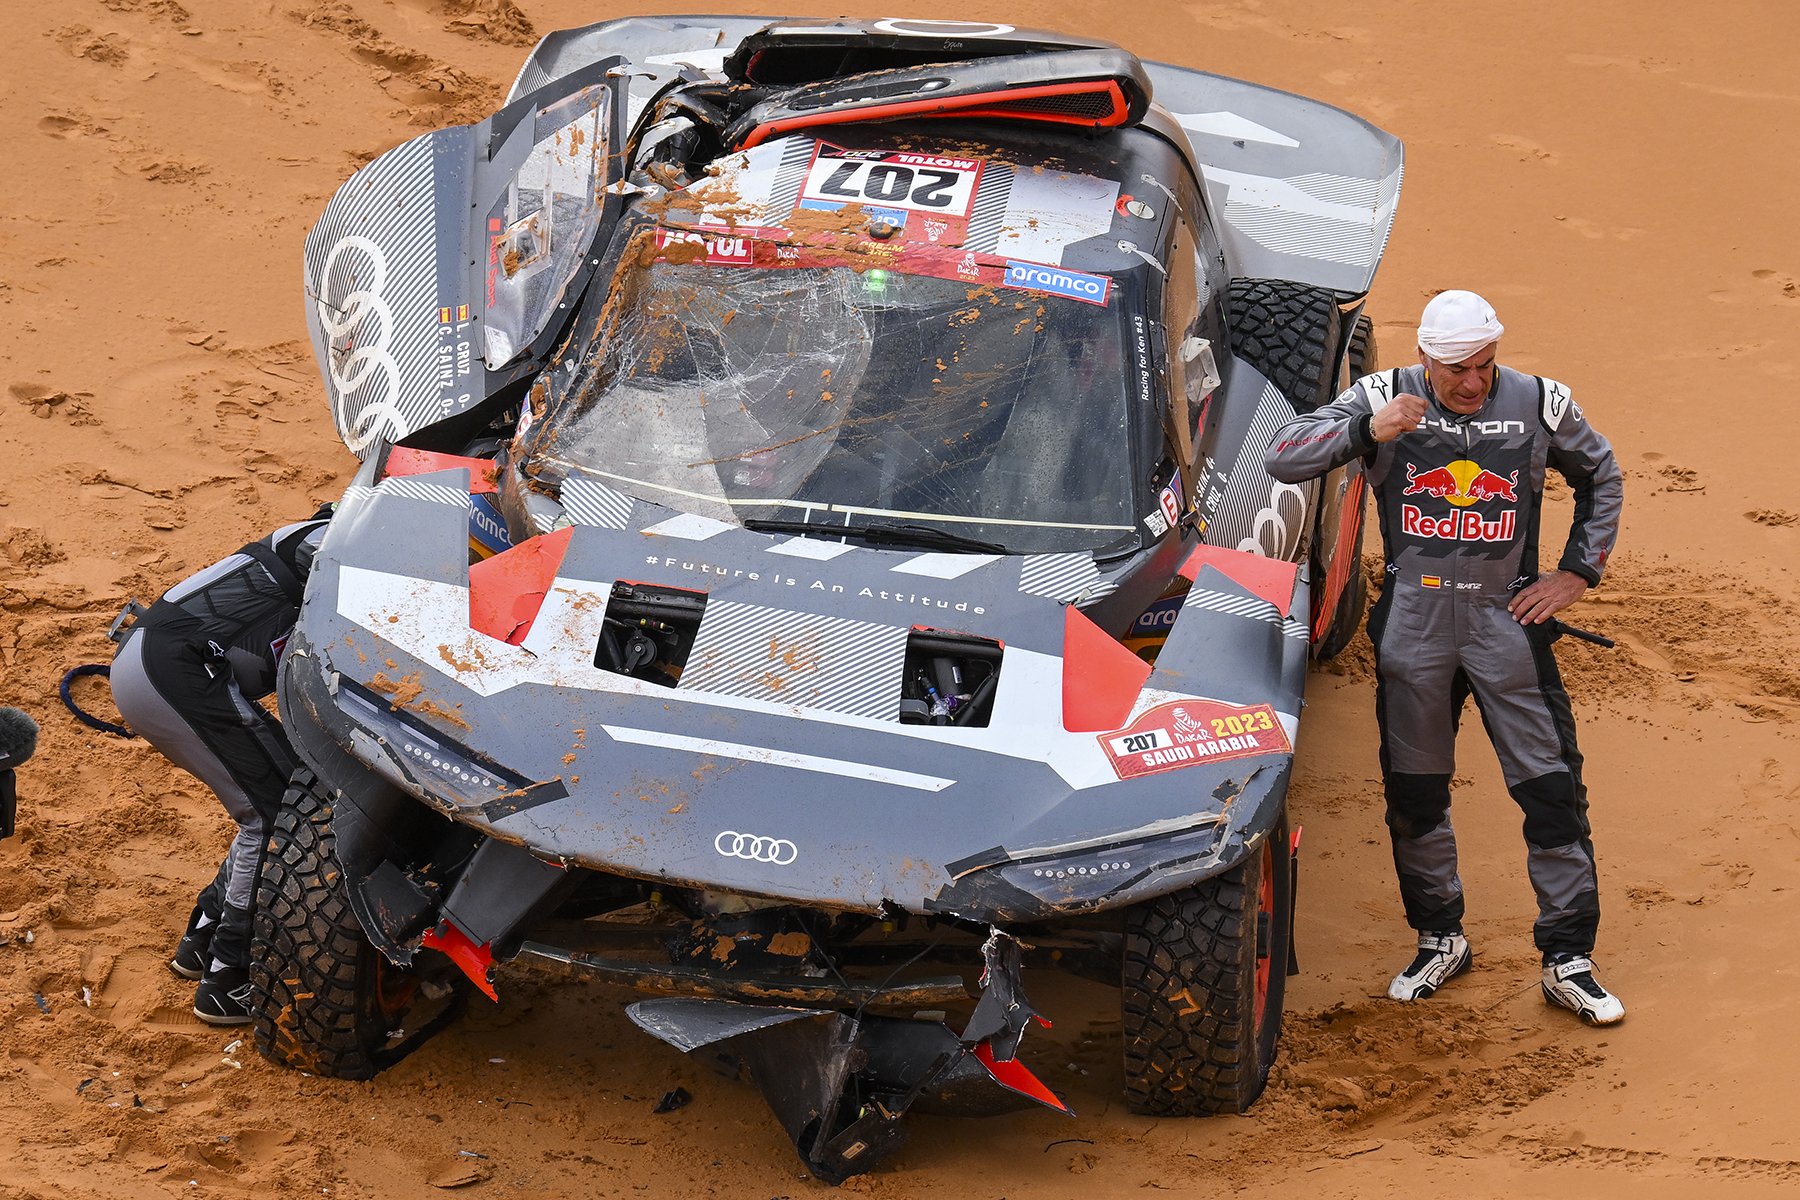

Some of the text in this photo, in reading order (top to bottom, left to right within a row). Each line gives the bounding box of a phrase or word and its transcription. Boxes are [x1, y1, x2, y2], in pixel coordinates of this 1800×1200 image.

[897, 154, 975, 169] MOTUL
[819, 162, 960, 207] 207
[486, 235, 499, 309] Audi Sport
[957, 264, 981, 277] DAKAR
[1011, 265, 1100, 294] aramco
[438, 326, 453, 341] C.
[456, 322, 470, 339] L.
[439, 345, 454, 389] SAINZ
[1134, 316, 1150, 401] Racing for Ken #43
[1196, 466, 1211, 499] SAINZ
[1163, 493, 1177, 523] E
[1205, 485, 1221, 513] CRUZ
[1201, 513, 1213, 525] L.
[1402, 504, 1516, 543] Red Bull
[645, 555, 987, 616] #Future Is An Attitude
[1456, 582, 1482, 590] SAINZ
[1123, 732, 1159, 753] 207
[1173, 711, 1274, 744] DAKAR 2023
[1142, 734, 1260, 767] SAUDI ARABIA
